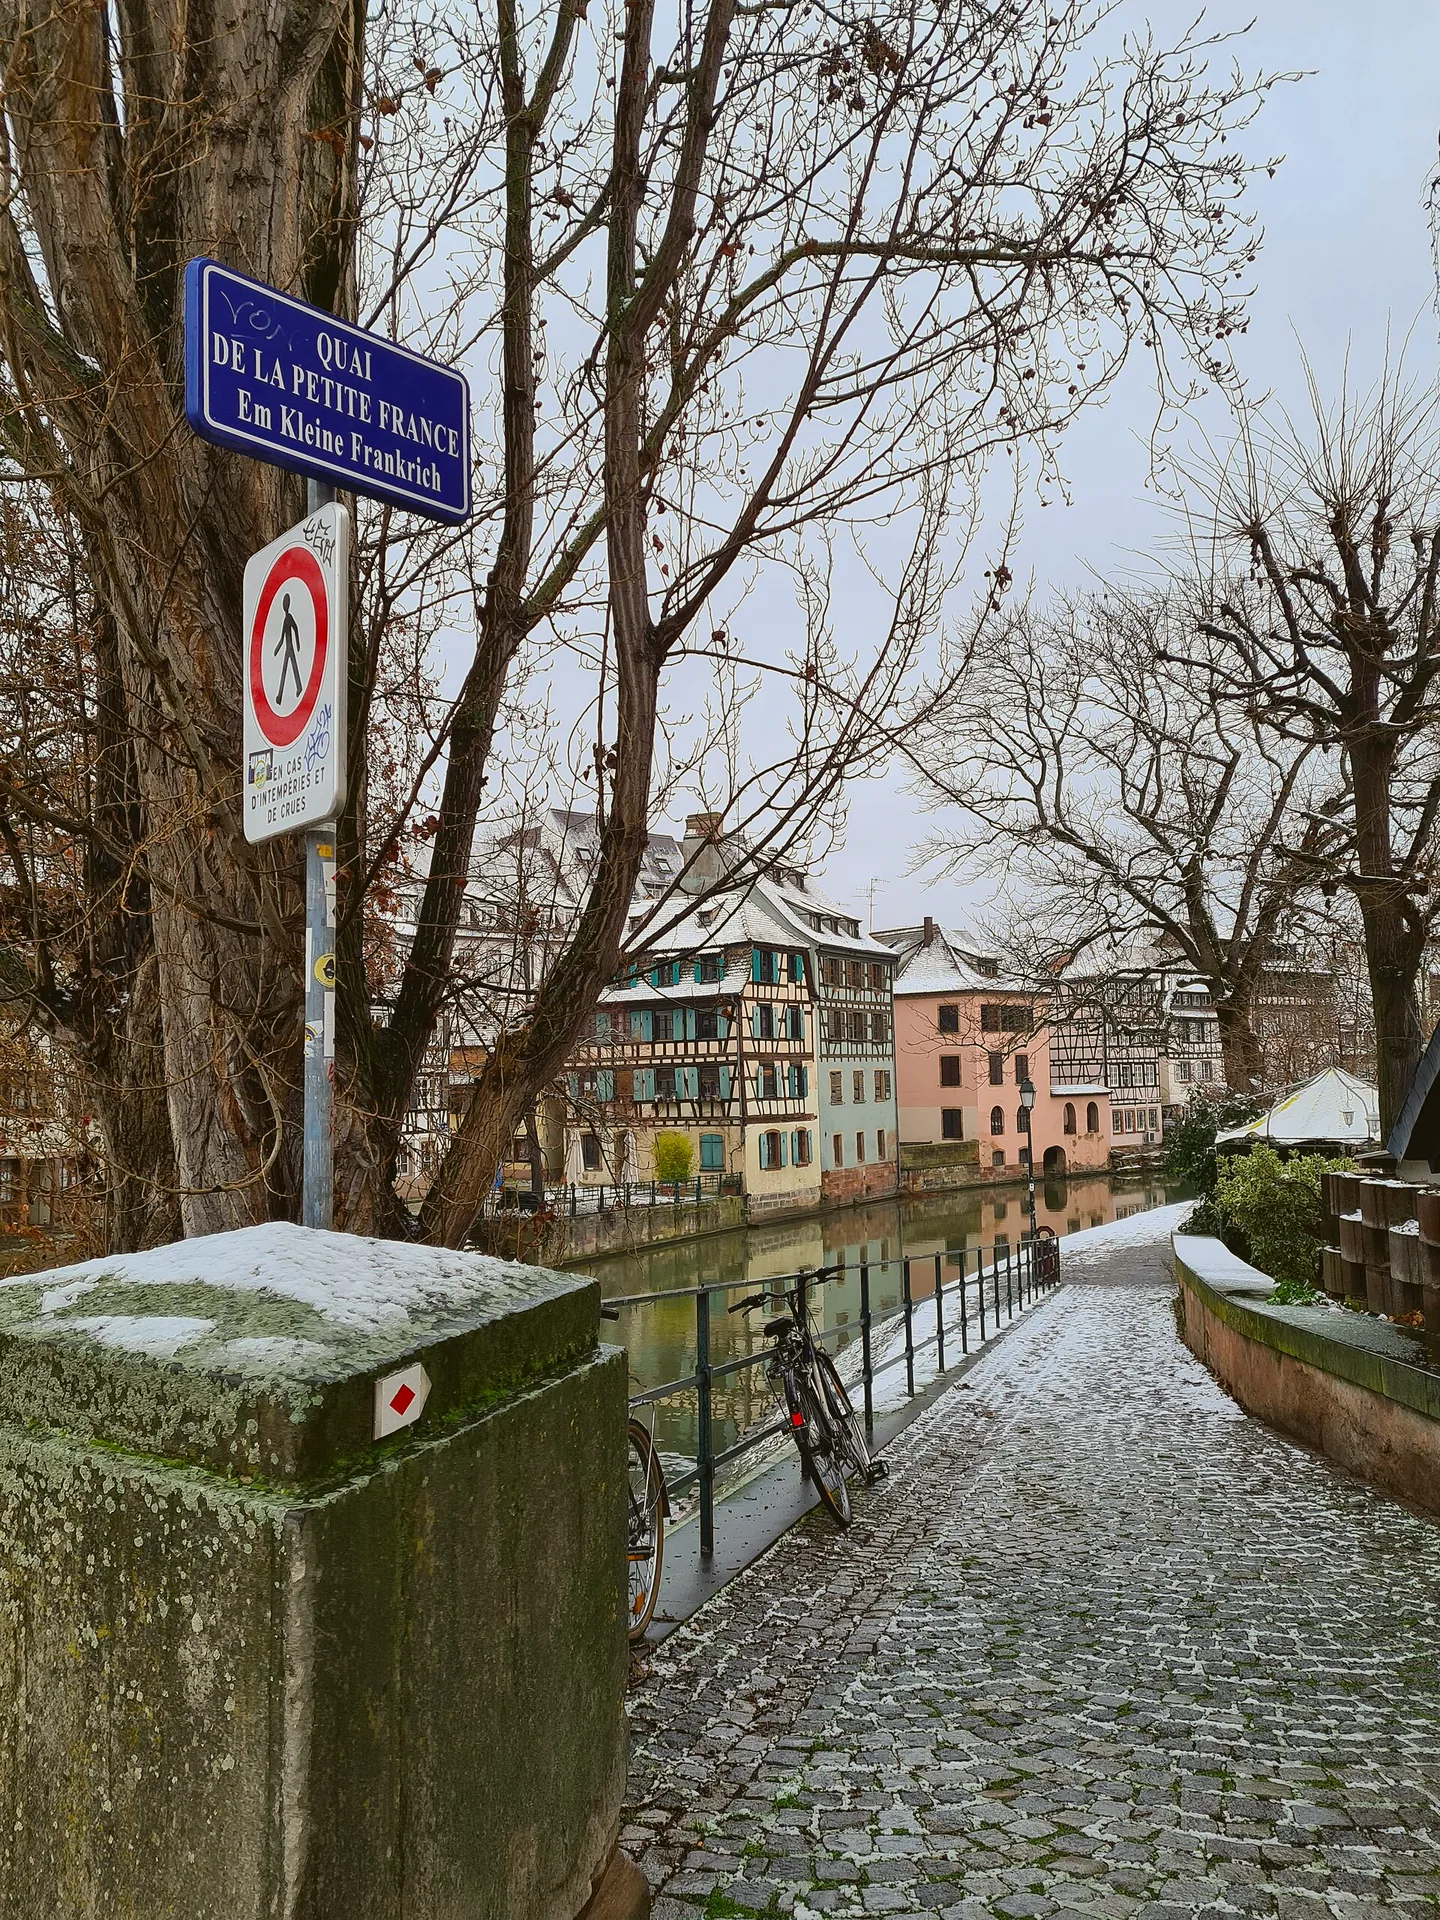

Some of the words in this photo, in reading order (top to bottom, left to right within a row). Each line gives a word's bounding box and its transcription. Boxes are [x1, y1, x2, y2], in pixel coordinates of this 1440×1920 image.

[316, 332, 372, 382] QUAI
[212, 331, 246, 374] DE
[253, 348, 285, 391] LA
[292, 364, 372, 424] PETITE
[378, 399, 460, 459] FRANCE
[237, 388, 273, 431] Em
[280, 404, 344, 456] Kleine
[350, 431, 442, 493] Frankrich
[251, 772, 311, 810] D'INTEMPÉRIES
[315, 767, 325, 785] ET
[273, 766, 283, 781] EN
[286, 756, 302, 776] CAS
[267, 807, 277, 824] DE
[281, 796, 306, 818] CRUES
